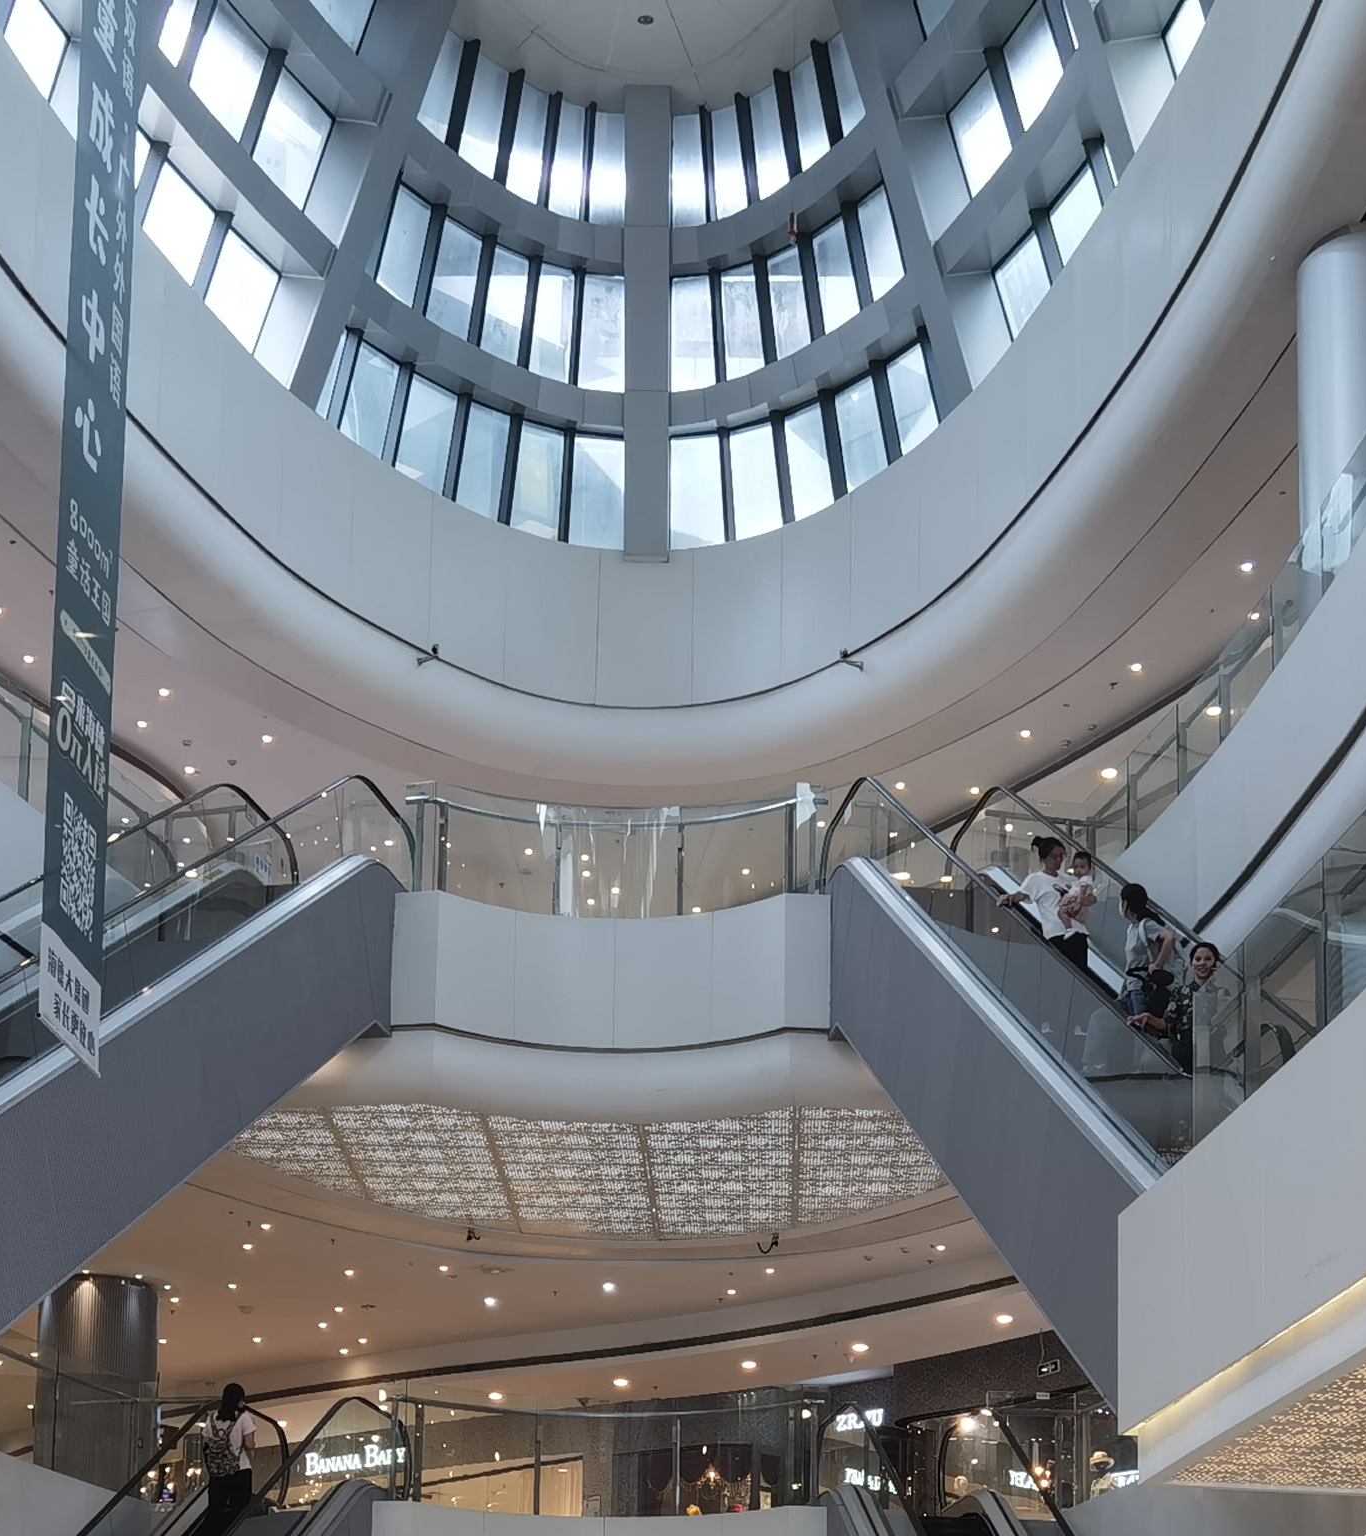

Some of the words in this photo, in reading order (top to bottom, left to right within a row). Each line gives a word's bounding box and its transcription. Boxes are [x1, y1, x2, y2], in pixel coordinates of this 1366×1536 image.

[65, 538, 112, 628] 童话王国
[305, 1452, 362, 1476] BANANA
